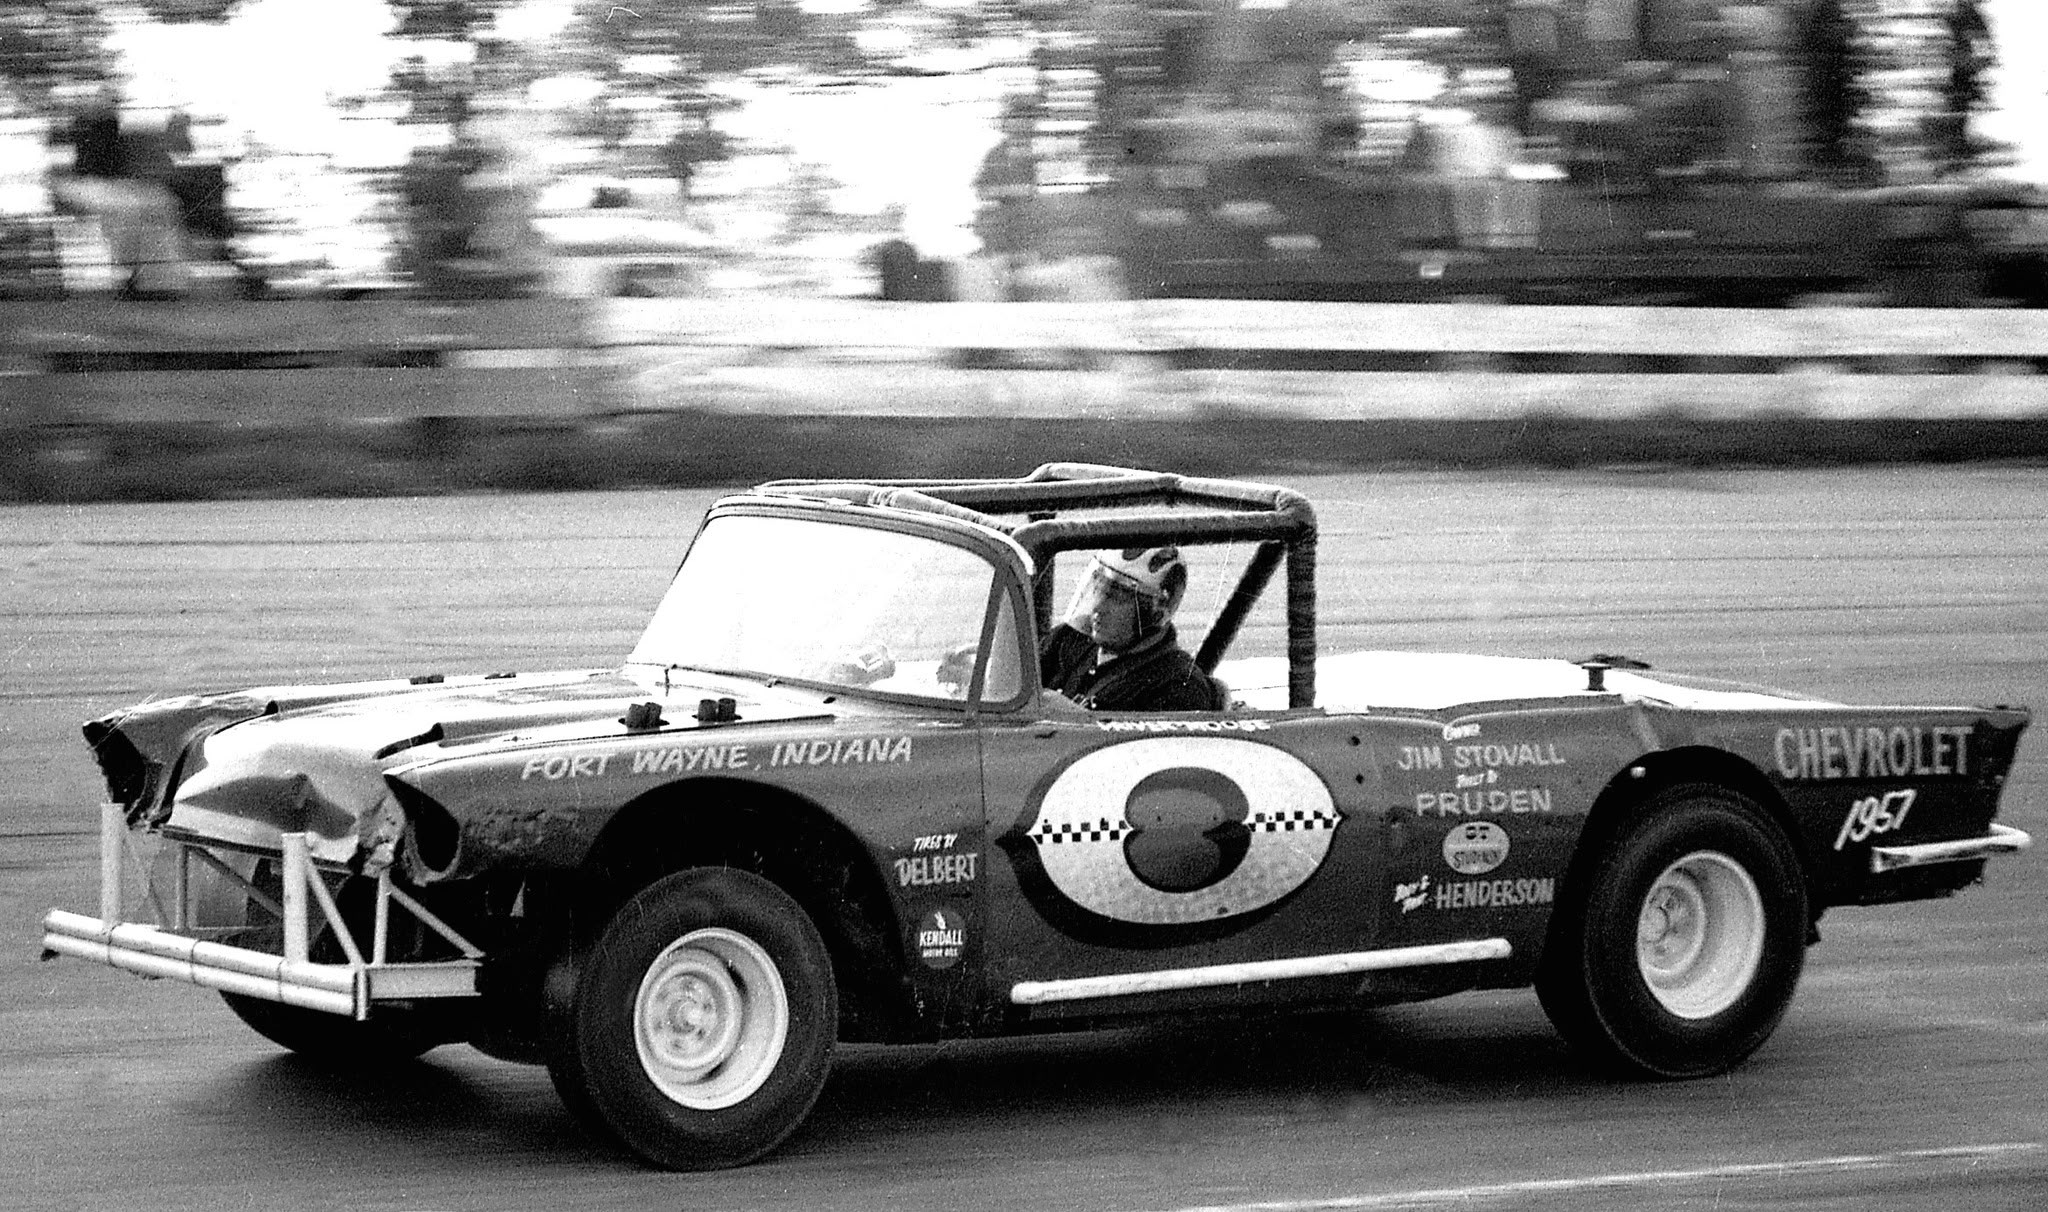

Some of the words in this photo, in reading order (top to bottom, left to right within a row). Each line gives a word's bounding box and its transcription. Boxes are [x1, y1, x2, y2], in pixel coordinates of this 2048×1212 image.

[522, 753, 614, 780] FORT
[770, 736, 913, 767] INDIANA
[1397, 746, 1443, 770] JIM
[1454, 744, 1566, 768] STOVALL
[1774, 725, 1974, 779] CHEVROLET
[1416, 788, 1552, 816] PRUDEN
[1027, 736, 1342, 924] 8
[894, 853, 978, 887] DELBERT
[1436, 878, 1555, 909] HENDERSON
[919, 929, 963, 947] KENDALL
